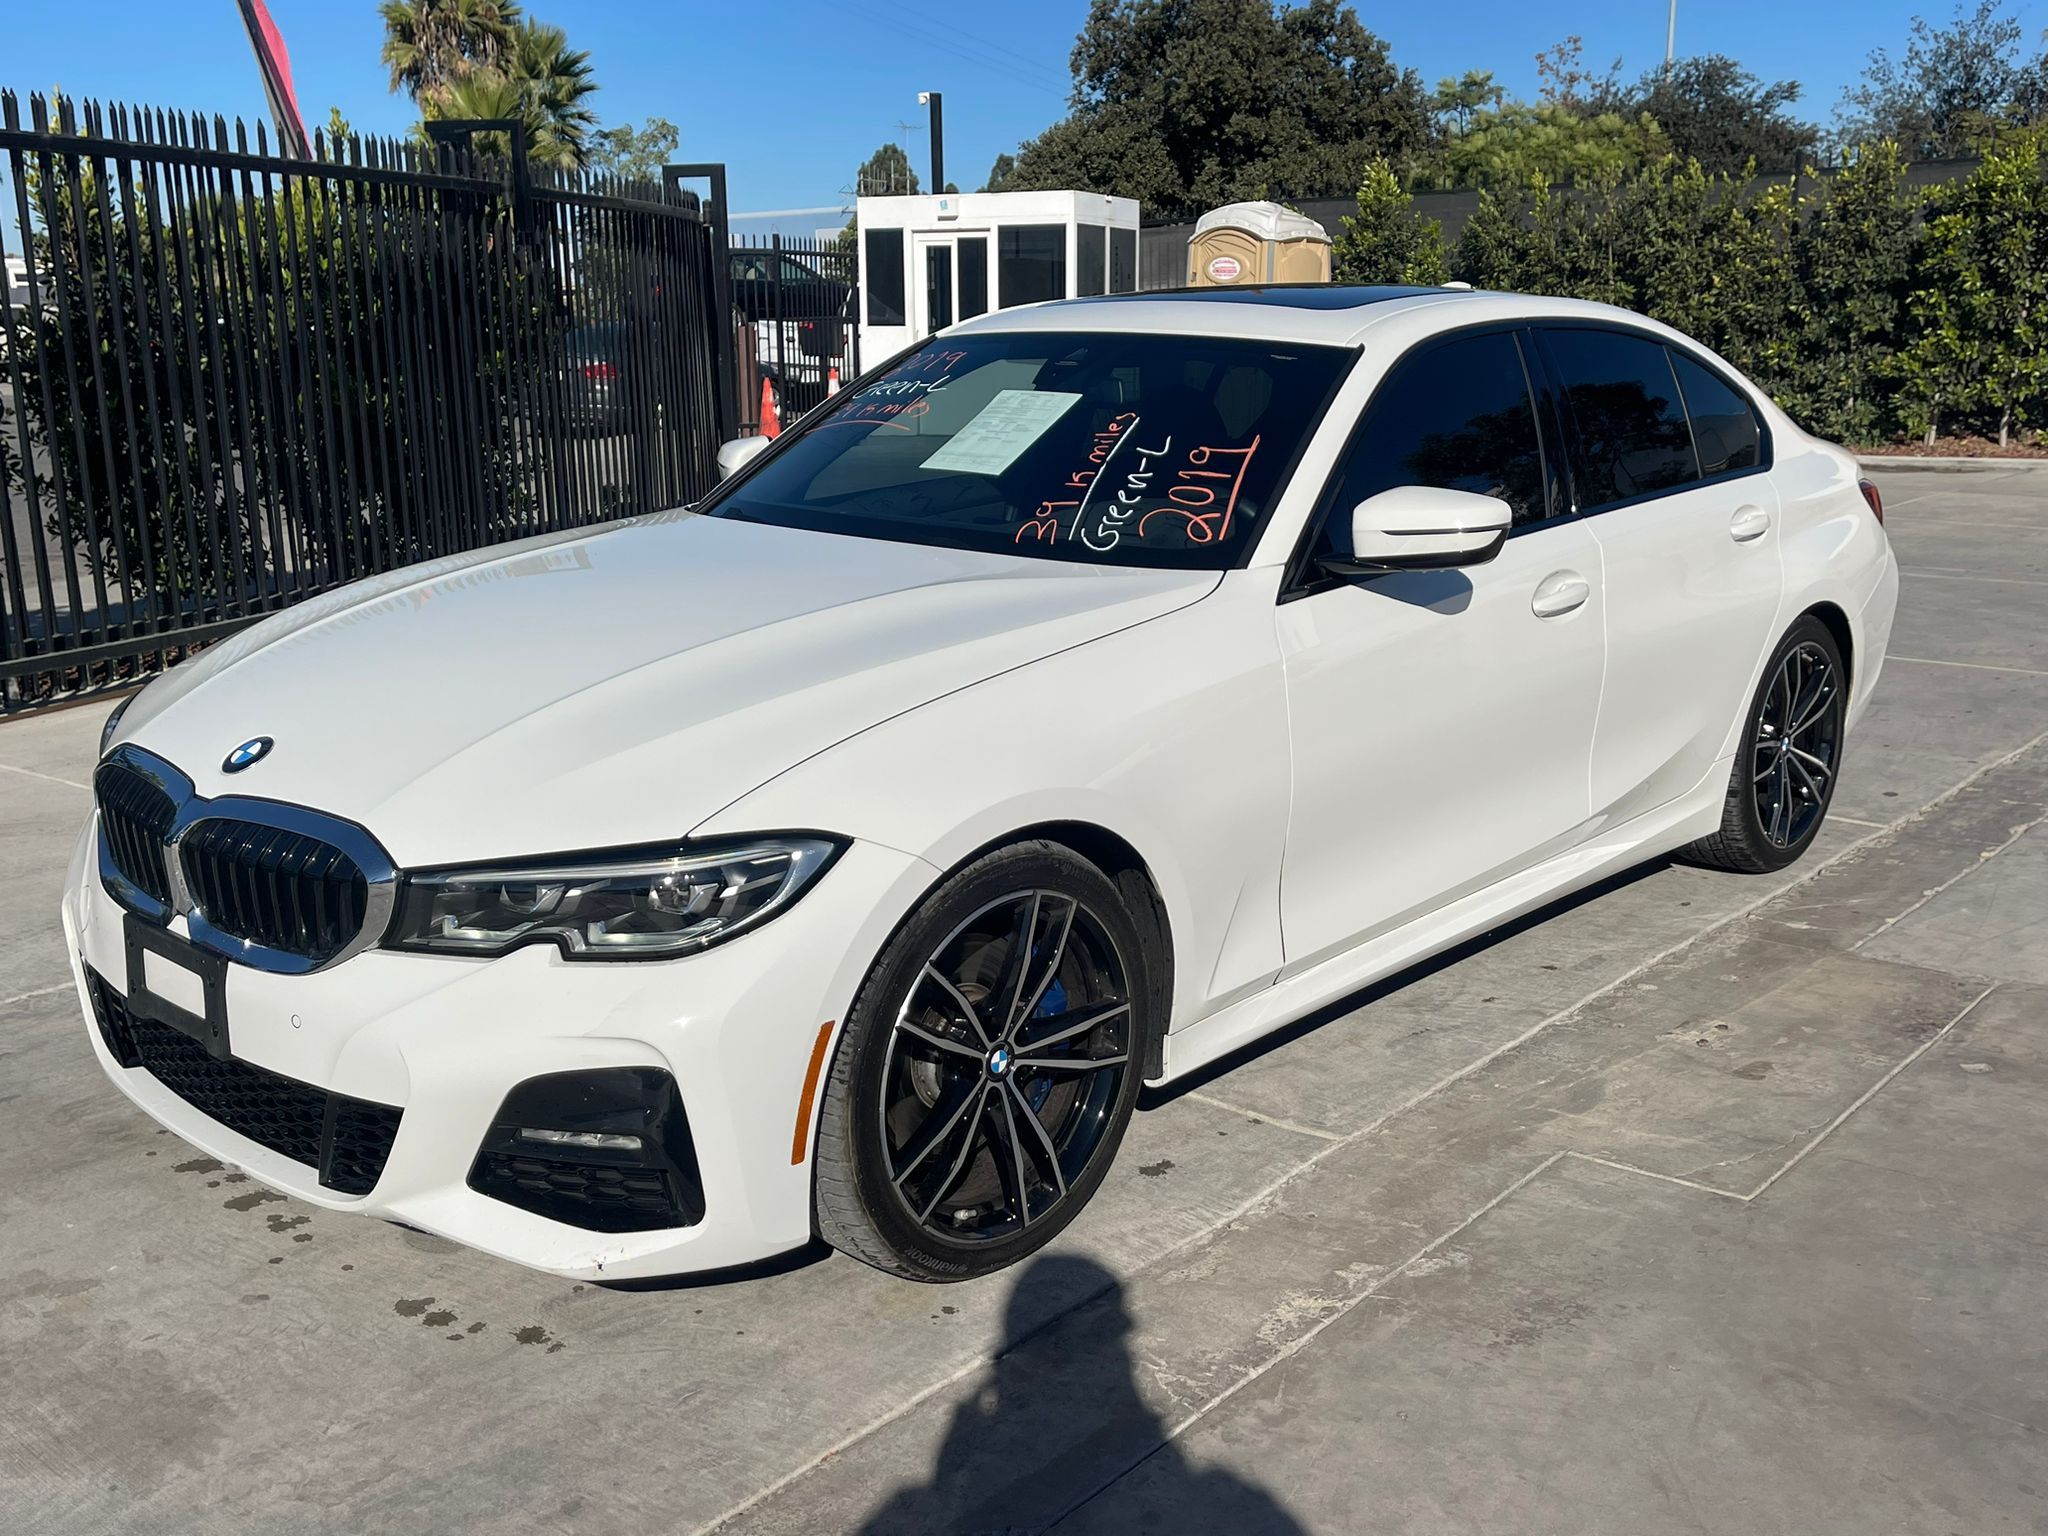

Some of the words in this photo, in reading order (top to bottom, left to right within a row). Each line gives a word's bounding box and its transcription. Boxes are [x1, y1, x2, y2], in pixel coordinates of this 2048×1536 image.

[1015, 501, 1080, 545] 39
[1088, 412, 1137, 464] miles
[1080, 435, 1172, 551] Green-L
[1138, 446, 1252, 543] 2019
